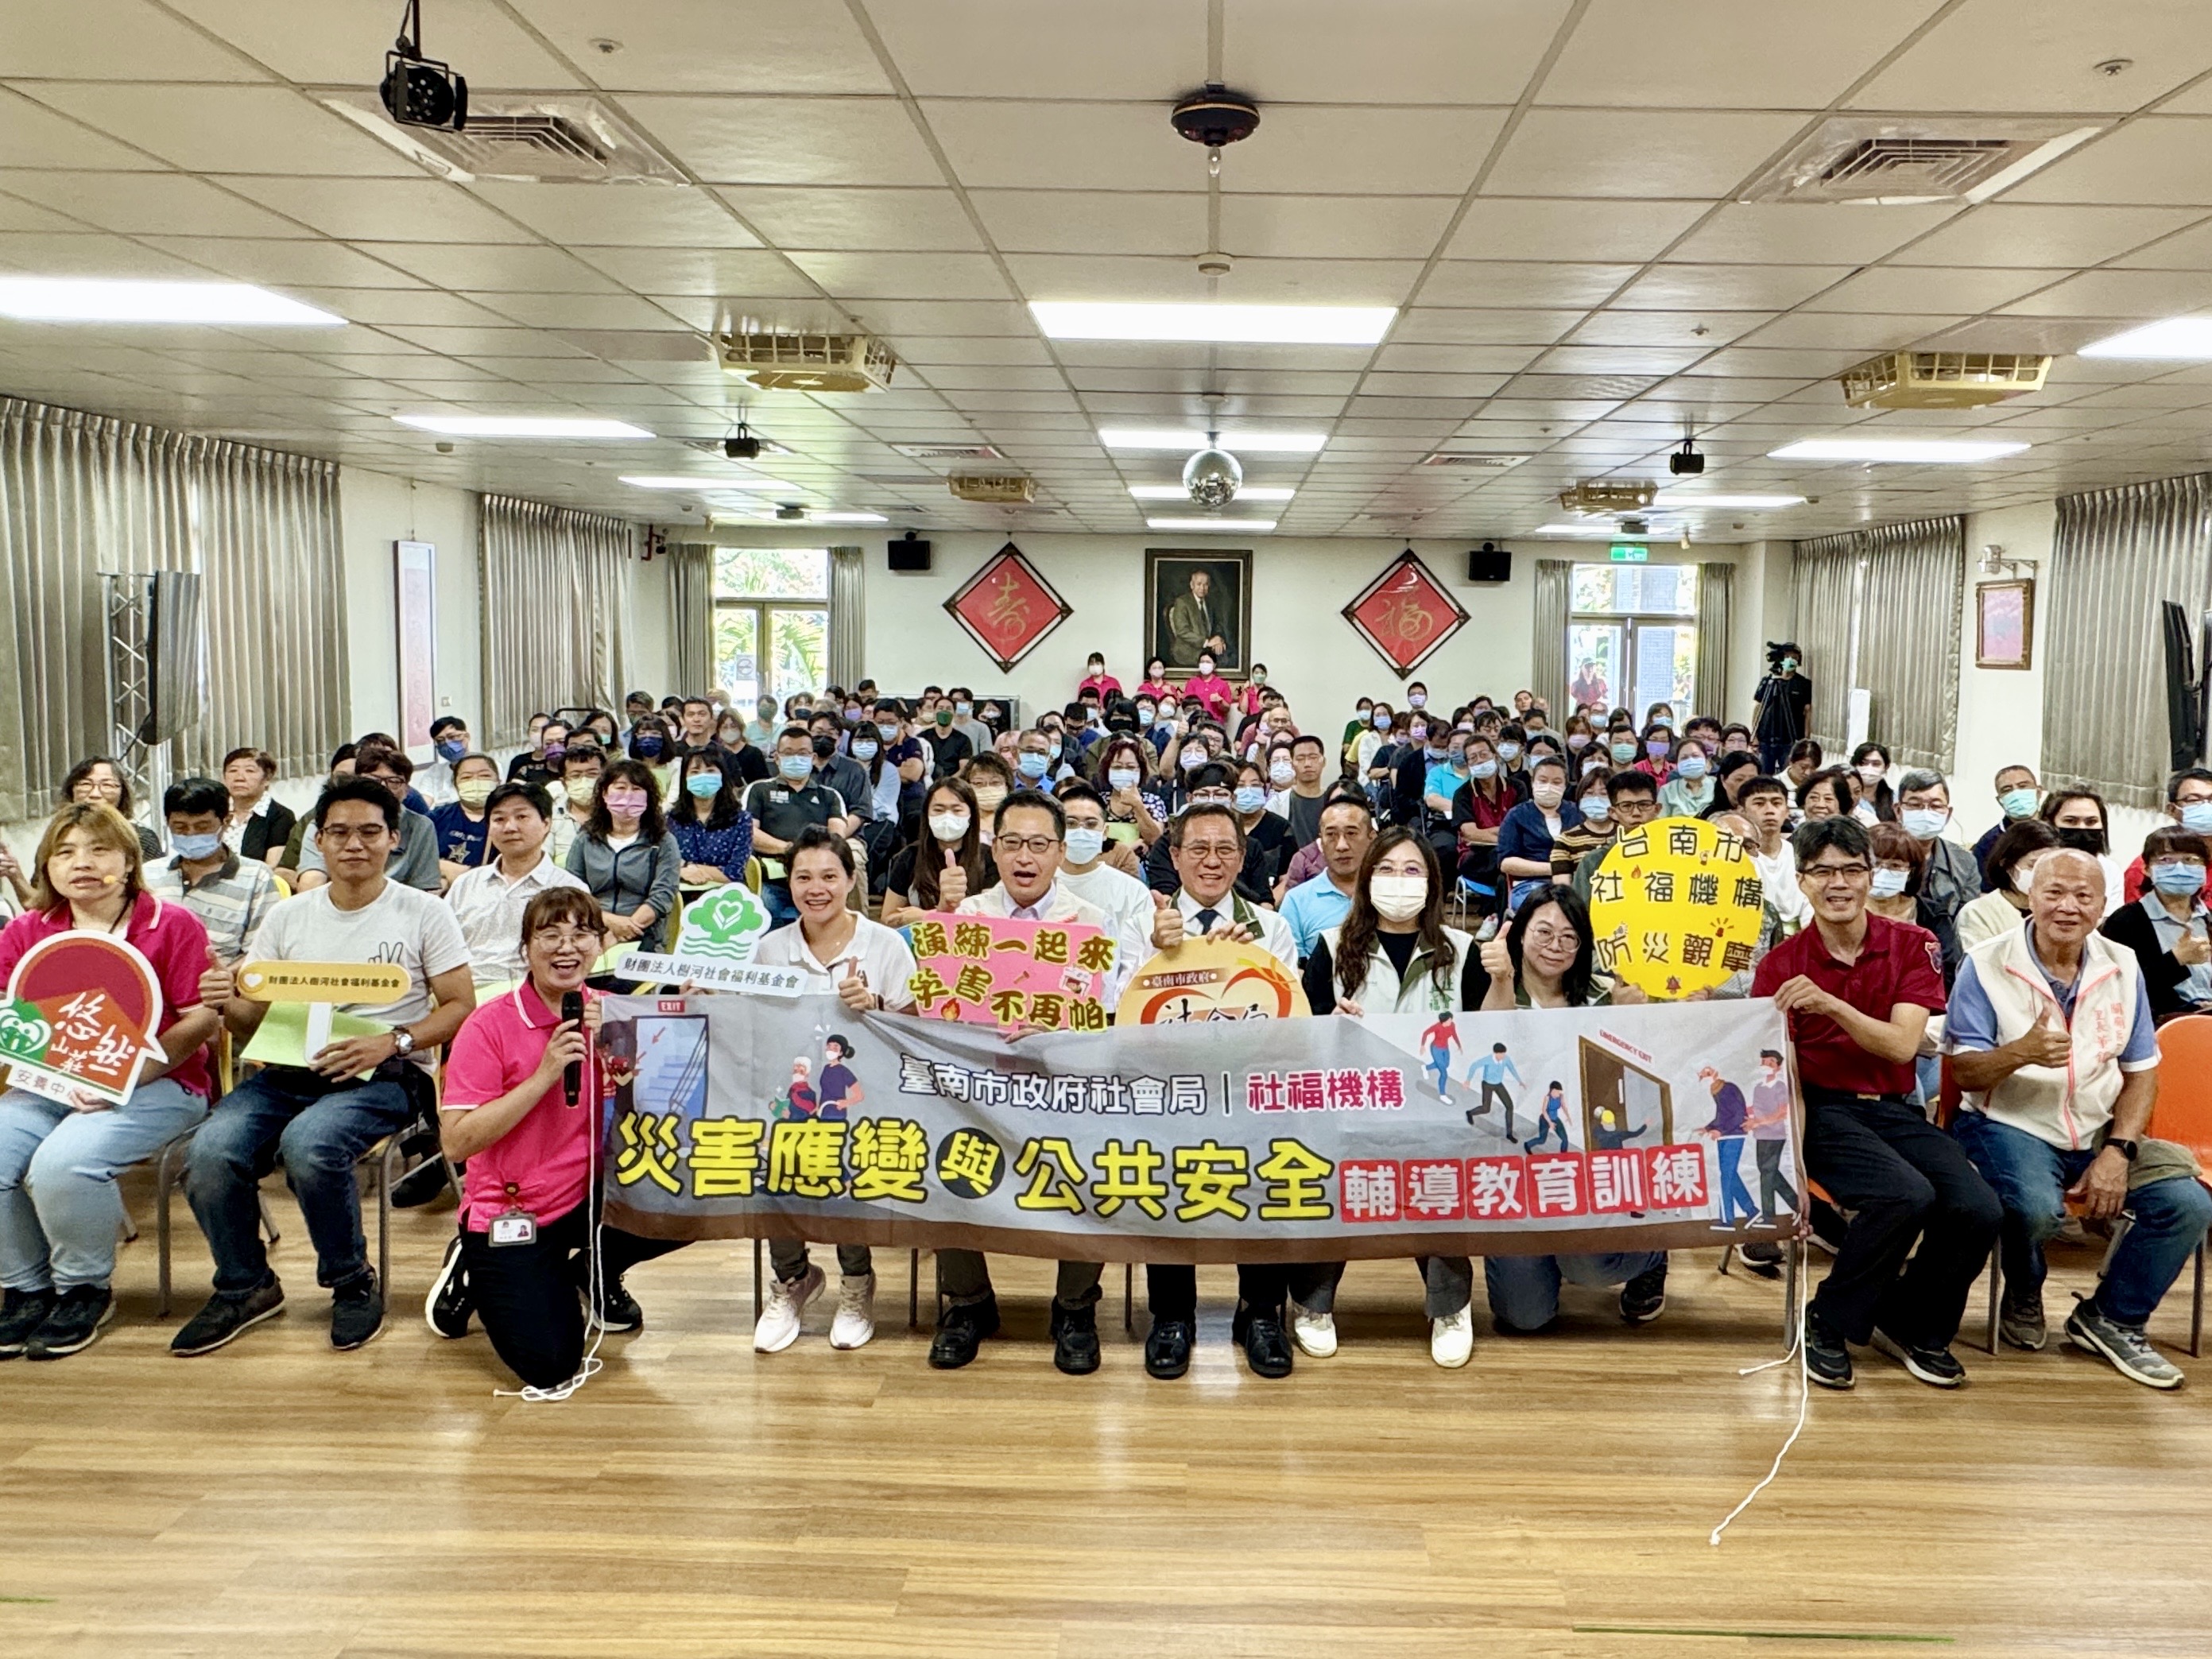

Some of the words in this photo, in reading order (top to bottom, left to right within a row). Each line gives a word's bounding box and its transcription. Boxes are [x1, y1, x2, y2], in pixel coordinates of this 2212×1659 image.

[1619, 824, 1743, 862] 台南市
[1592, 870, 1763, 911] 社福機構
[913, 921, 1114, 971] 演練一起來
[1597, 932, 1755, 971] 防災觀摩
[268, 975, 400, 987] 財團法人樹河社會福利基金會
[624, 957, 800, 989] 財團法人樹河社會福利基金會
[661, 1002, 681, 1011] EXIT
[55, 991, 136, 1076] 悠然
[50, 1036, 88, 1073] 山莊
[899, 1052, 1207, 1114] 臺南市政府社會局
[1248, 1069, 1404, 1111] 社福機構
